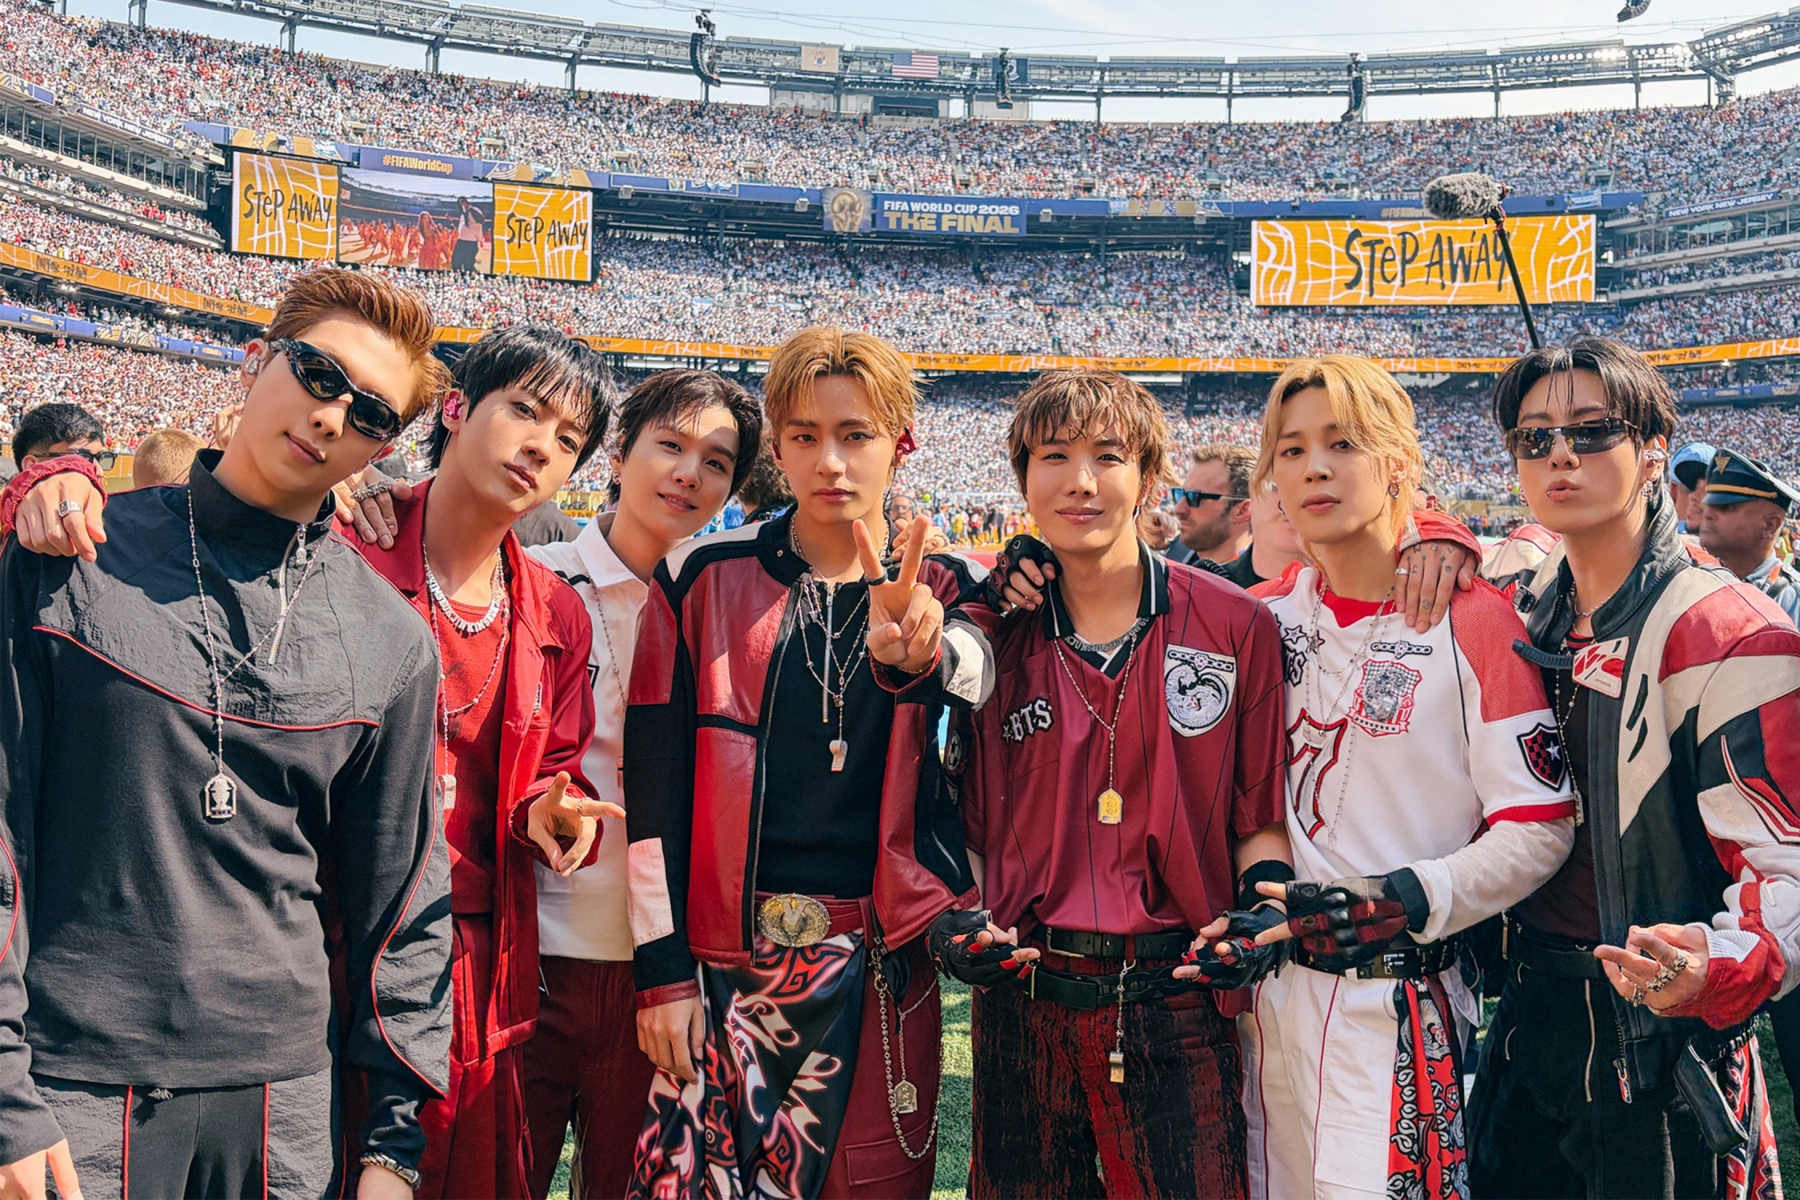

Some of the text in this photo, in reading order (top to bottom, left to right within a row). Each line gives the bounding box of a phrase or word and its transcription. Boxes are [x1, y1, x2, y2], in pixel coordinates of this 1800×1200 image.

[83, 106, 172, 146] NEW YORK NEW JERSEY
[382, 154, 453, 174] #FIFAWorldCup
[287, 193, 333, 229] AWAY
[884, 200, 1020, 215] FIFA WORLD CUP 2026
[884, 211, 1019, 233] THE FINAL
[1668, 193, 1774, 218] NEW YORK NEW JERSEY
[547, 219, 589, 251] AWAY
[1426, 230, 1510, 292] AWAY
[1284, 649, 1307, 688] TS
[1009, 699, 1053, 741] BTS
[1287, 707, 1348, 840] 7
